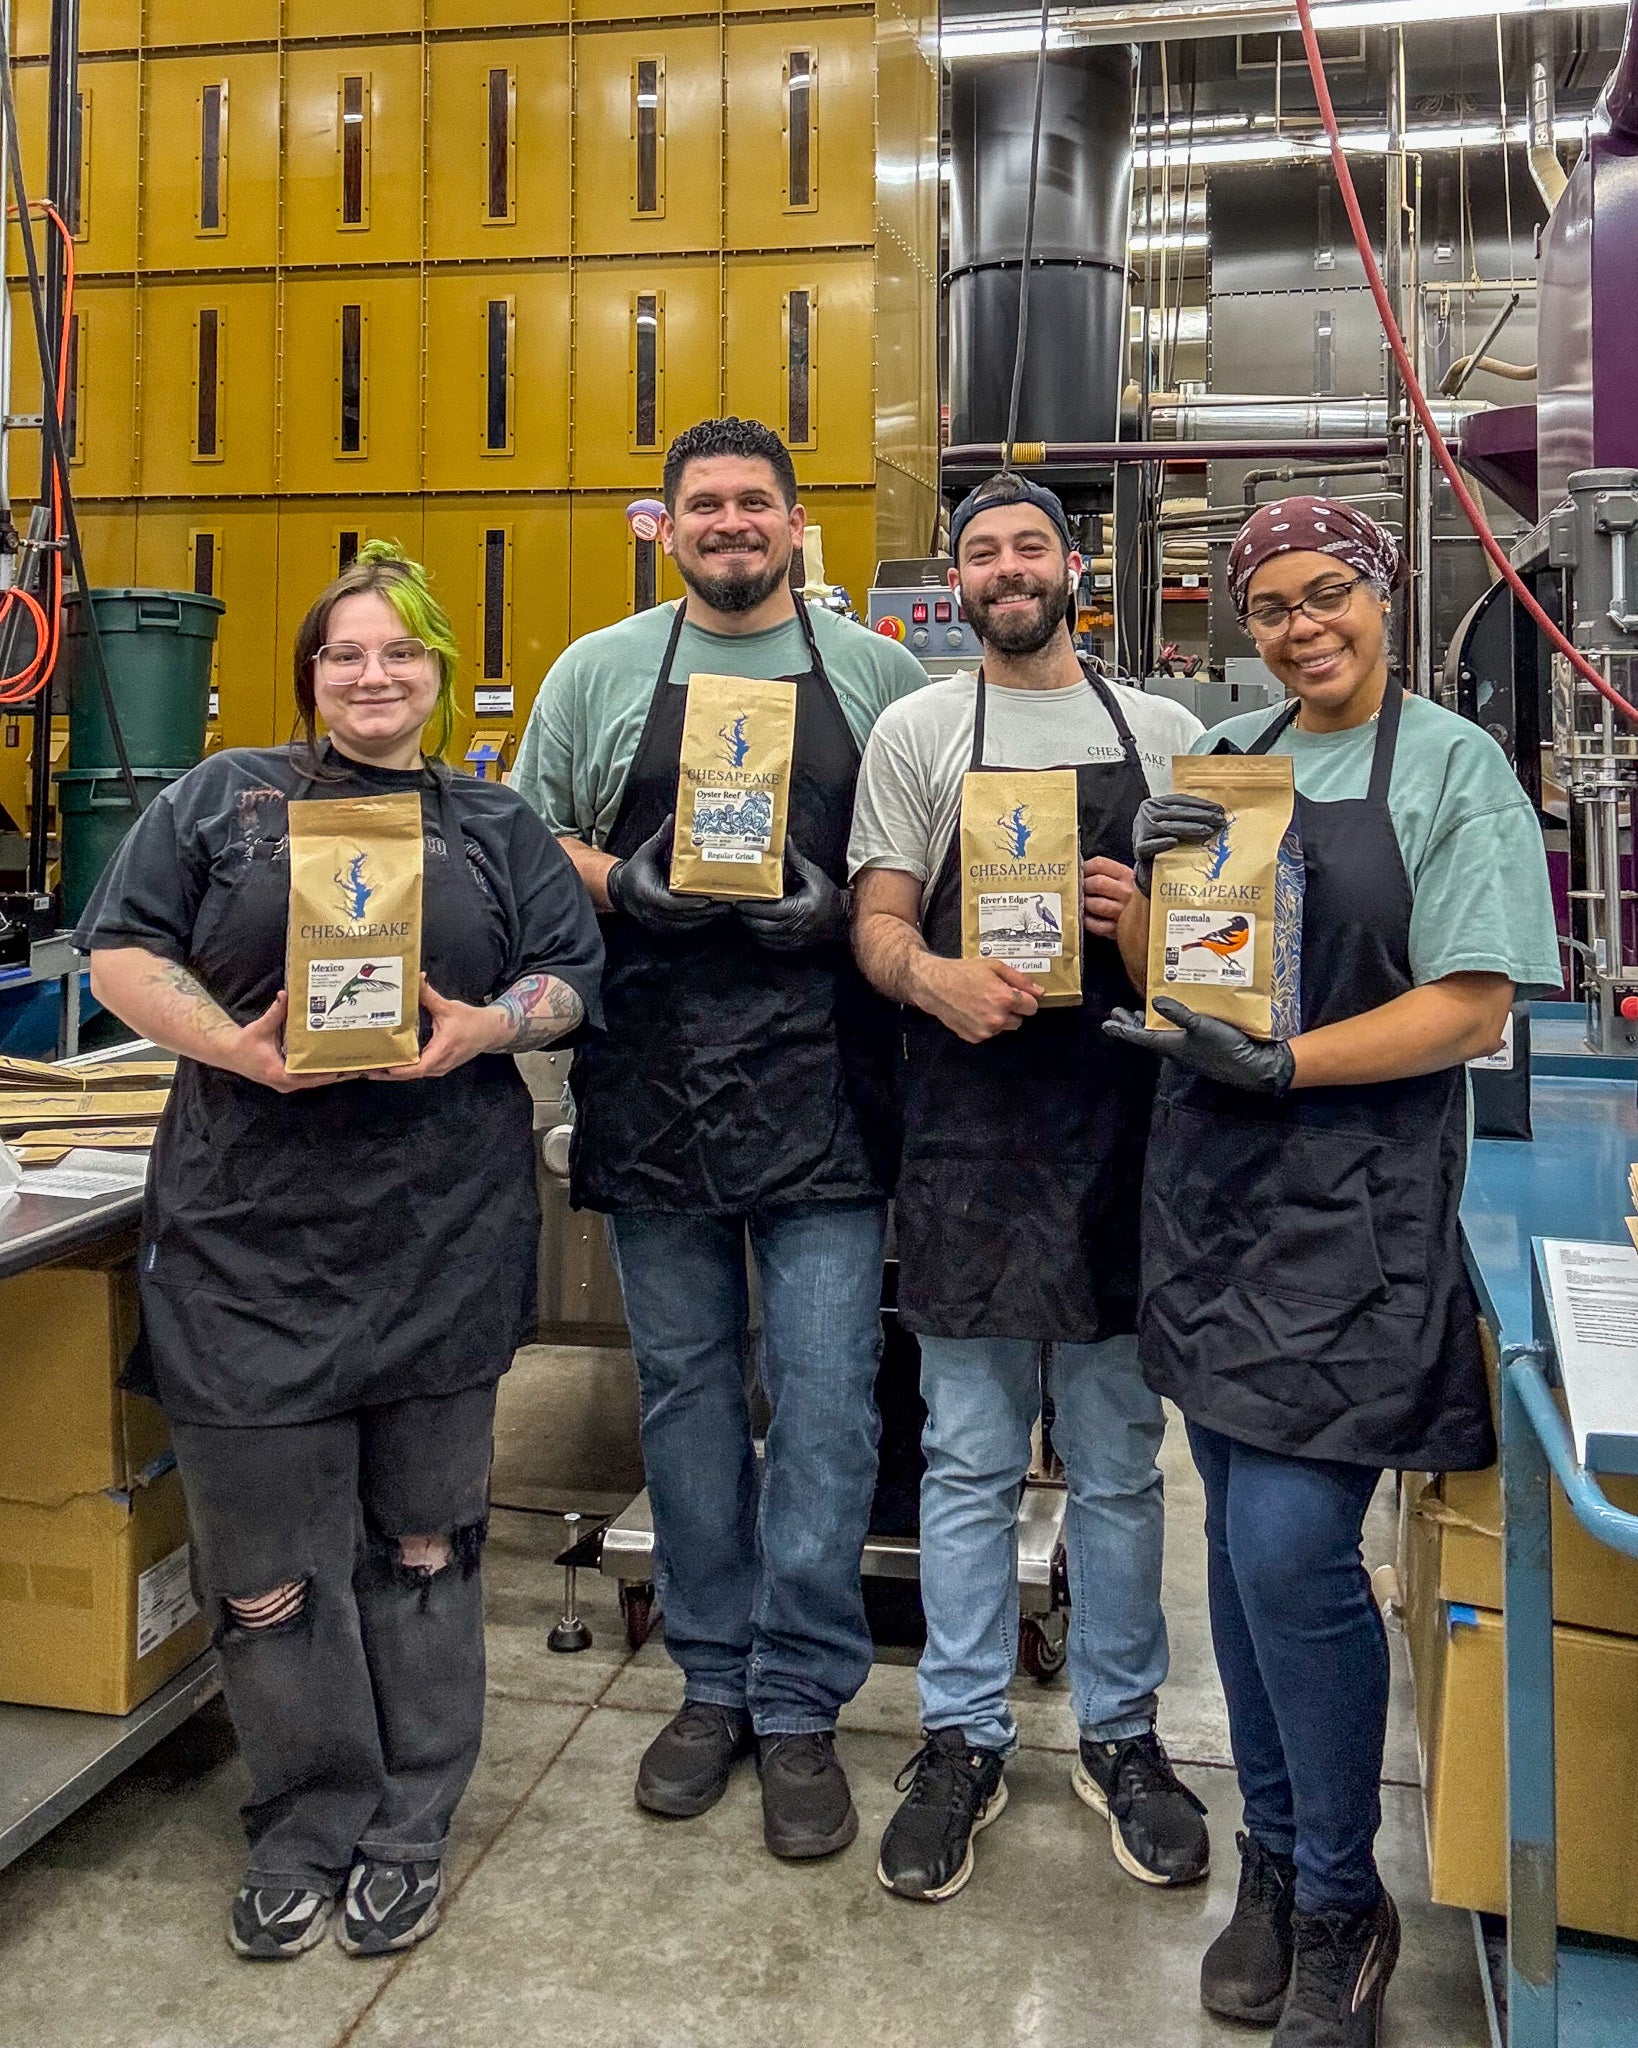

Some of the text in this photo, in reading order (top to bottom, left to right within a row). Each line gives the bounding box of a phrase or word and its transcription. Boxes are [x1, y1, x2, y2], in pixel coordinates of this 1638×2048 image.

[1087, 746, 1165, 767] CHESAKE
[687, 768, 779, 785] CHESAPEAKE
[696, 790, 741, 800] Oyster Reef
[707, 851, 755, 860] Regular Grind
[970, 863, 1066, 877] CHESAPEAKE
[1160, 882, 1261, 900] CHESAPEAKE
[980, 895, 1029, 905] River's Edge
[1169, 912, 1210, 923] Guatemala
[301, 922, 411, 939] CHESAPEAKE
[311, 963, 344, 973] Mexico
[1022, 961, 1042, 969] Grind
